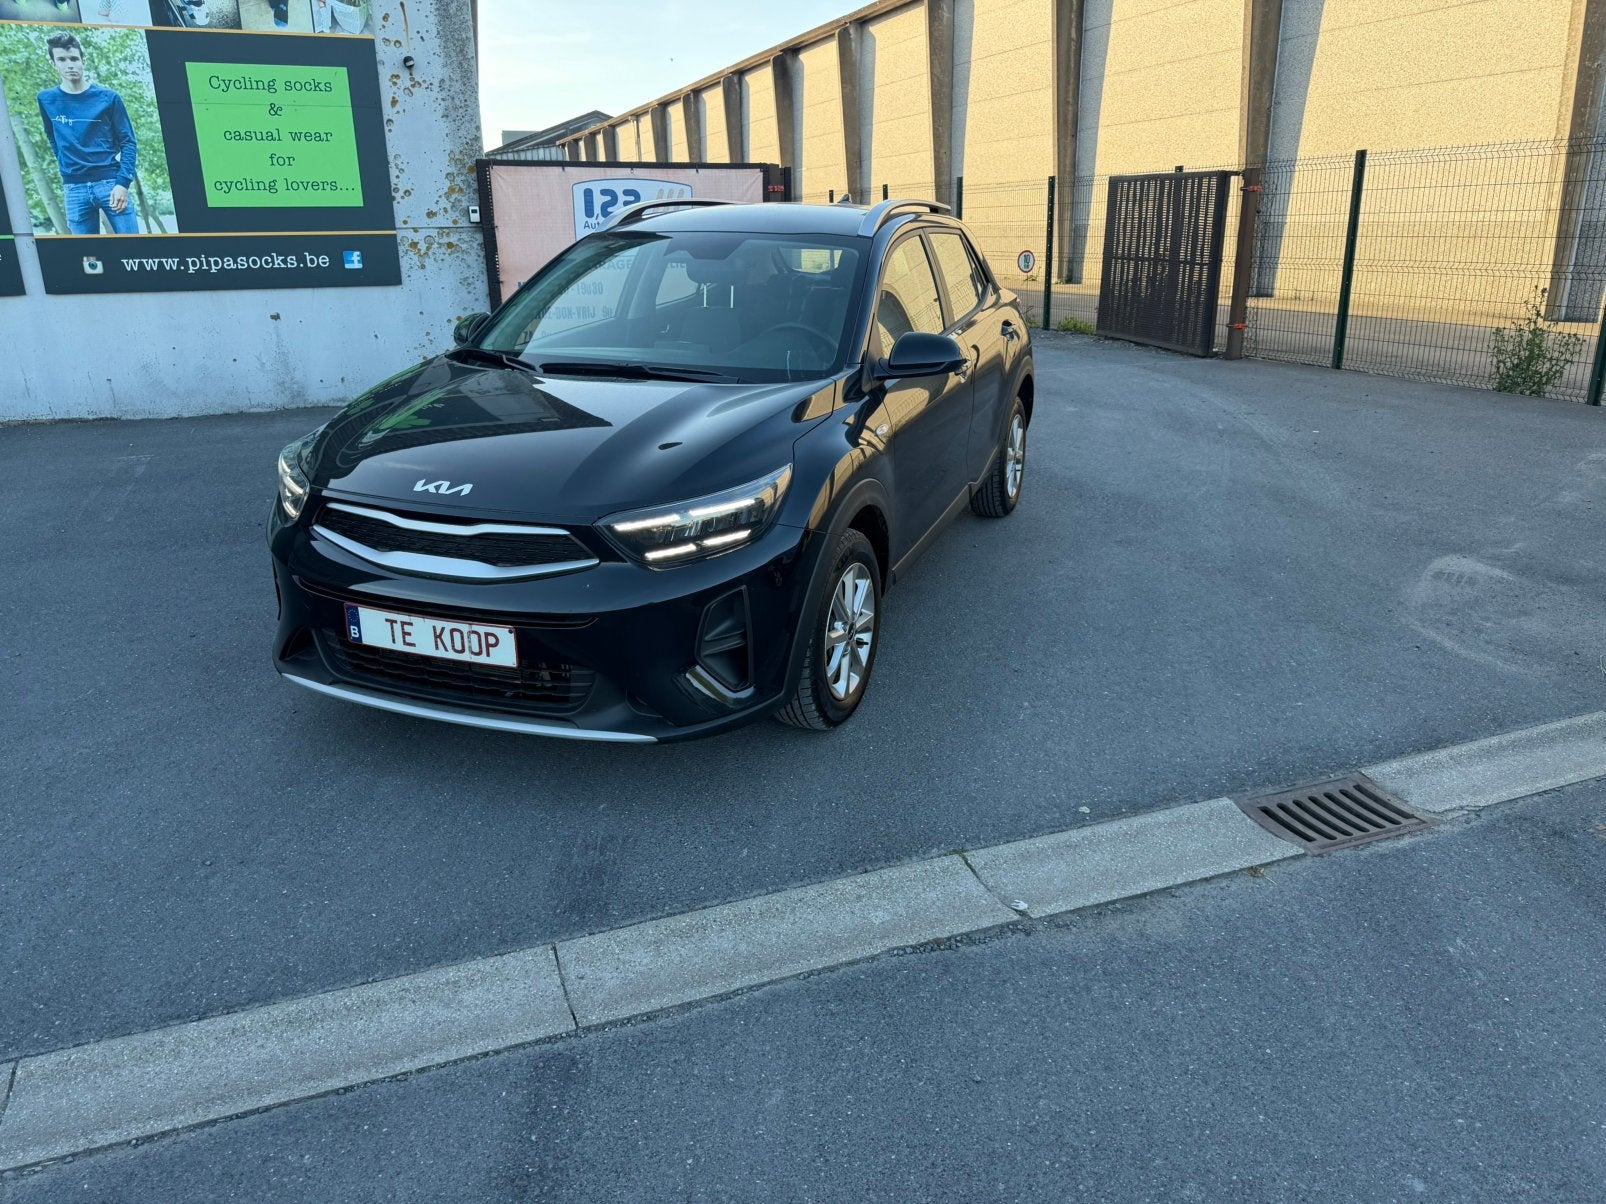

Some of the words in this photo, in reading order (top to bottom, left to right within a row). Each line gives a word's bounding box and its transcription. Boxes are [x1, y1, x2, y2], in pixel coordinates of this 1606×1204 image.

[208, 75, 278, 94] Cycling
[284, 78, 333, 93] socks
[268, 103, 283, 117] &
[223, 128, 282, 142] casual
[288, 130, 333, 143] wear
[269, 152, 296, 167] for
[213, 178, 278, 195] cycling
[121, 253, 330, 275] www.pipasocks.be
[413, 479, 473, 496] KIA
[350, 625, 360, 638] B
[385, 618, 416, 647] TE
[432, 625, 500, 658] KOOP
